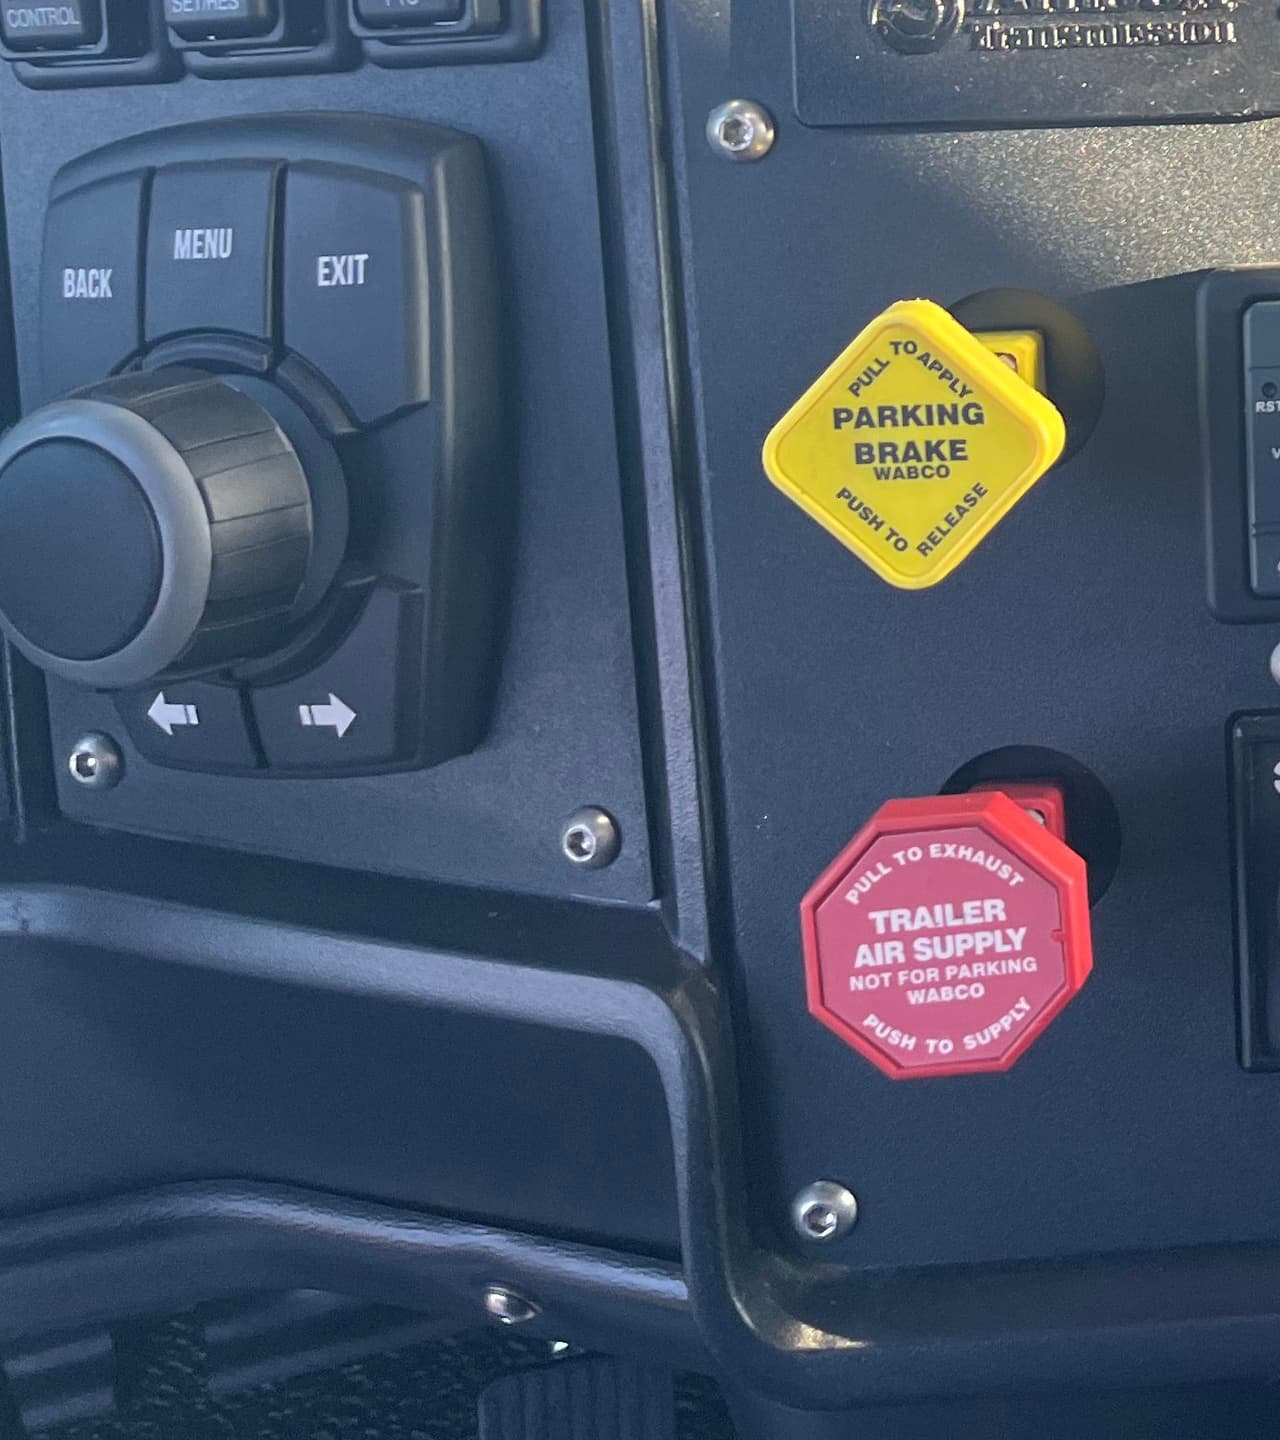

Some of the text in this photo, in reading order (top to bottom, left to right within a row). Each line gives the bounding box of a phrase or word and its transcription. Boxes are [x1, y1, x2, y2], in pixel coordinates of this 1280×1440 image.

[8, 7, 80, 28] CONTROL
[174, 228, 233, 260] MENU
[64, 268, 112, 298] BACK
[318, 254, 368, 287] EXIT
[848, 340, 974, 398] PULL TO APPLY
[833, 403, 985, 429] PARKING
[854, 439, 968, 464] BRAKE
[874, 464, 950, 480] WABCO
[836, 482, 989, 557] PUSH TO RELEASE
[845, 843, 1024, 905] PULL TO EXHAUST
[868, 898, 1006, 934] TRAILER
[854, 927, 1027, 968] AIR SUPPLY
[850, 957, 1037, 991] NOT FOR PARKING
[907, 983, 985, 1004] WABCO
[863, 997, 1031, 1054] PUSH TO SUPPLY
